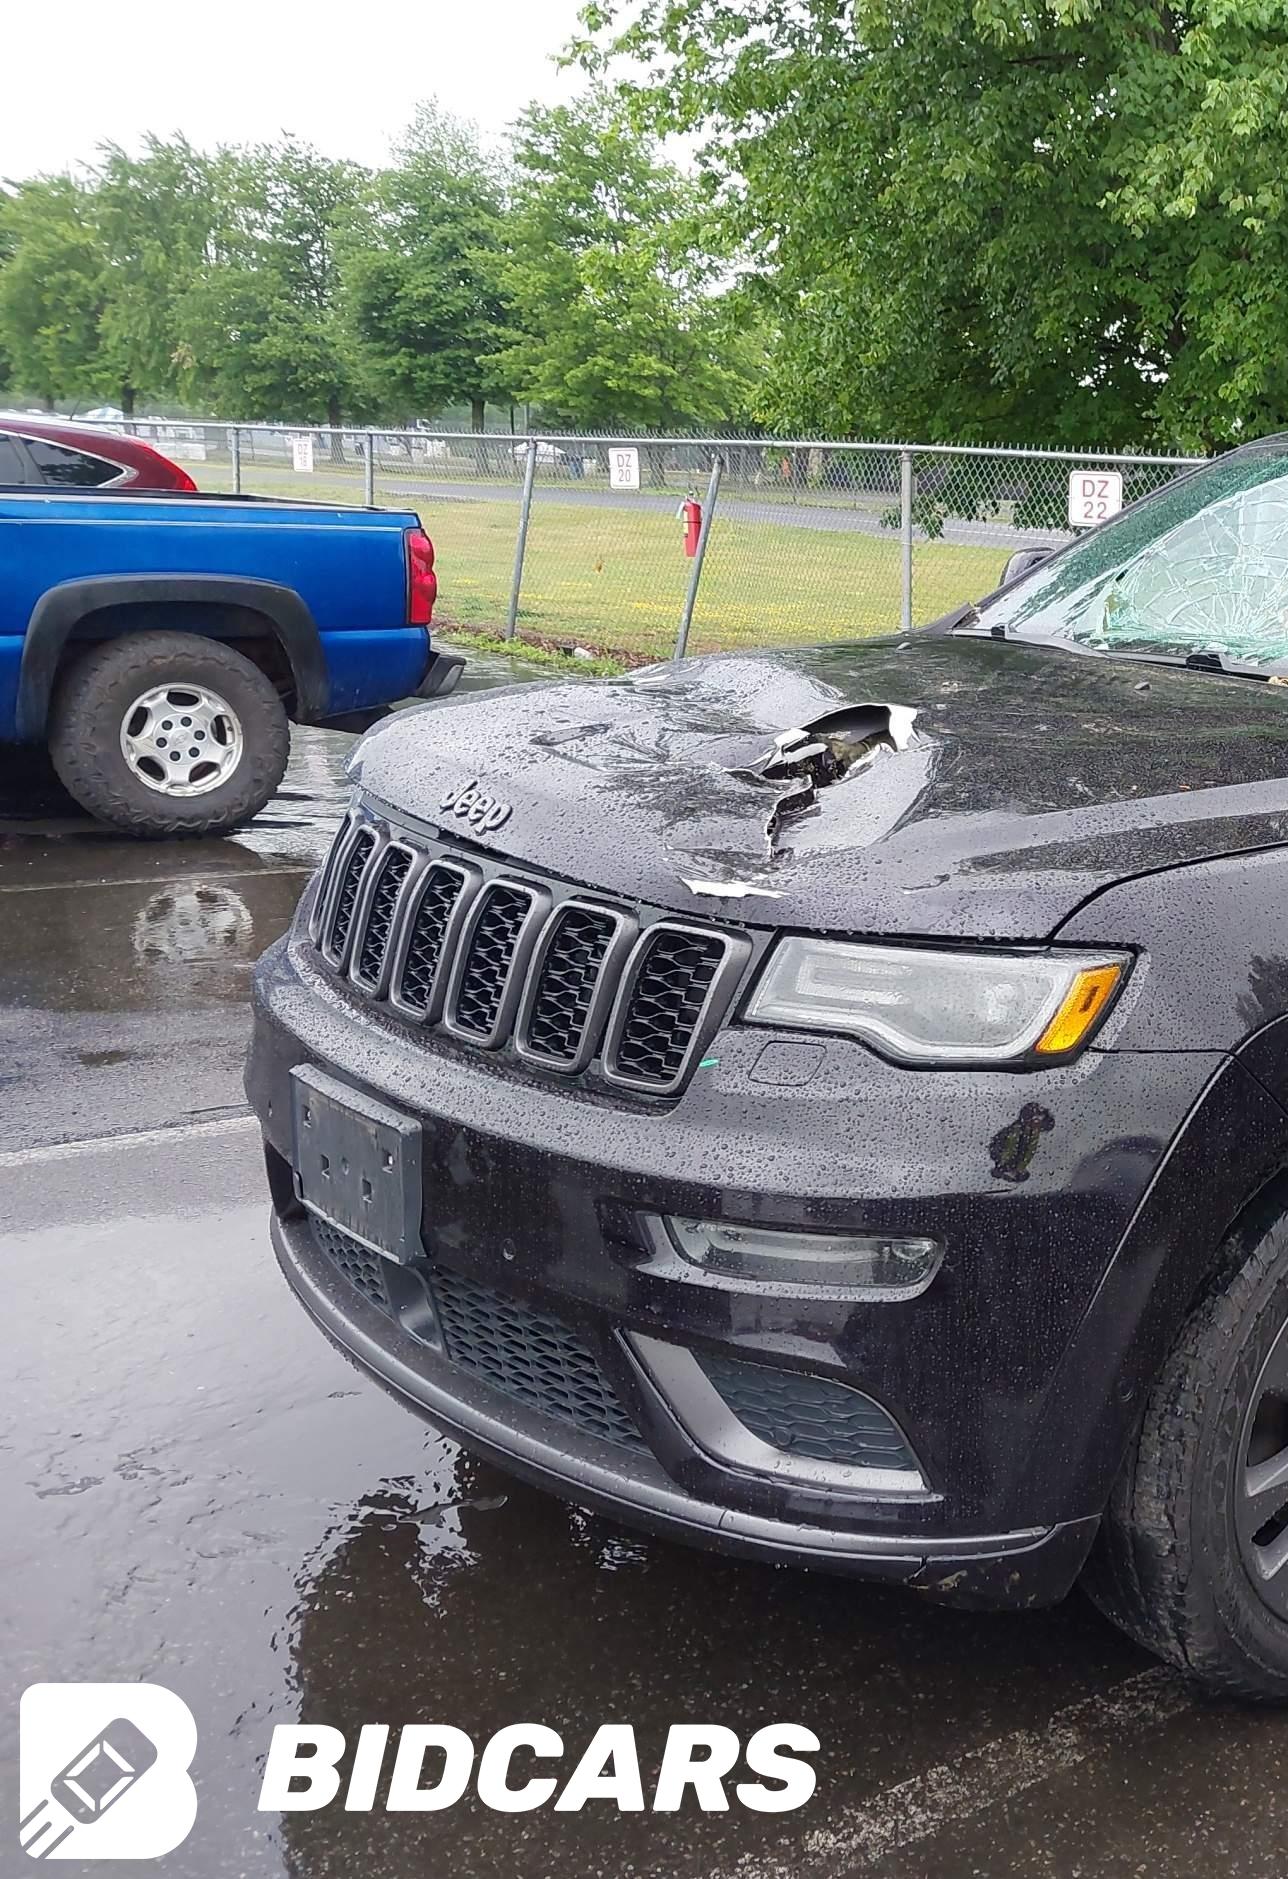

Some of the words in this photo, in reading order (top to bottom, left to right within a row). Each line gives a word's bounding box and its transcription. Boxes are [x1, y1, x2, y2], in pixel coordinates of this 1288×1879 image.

[616, 453, 632, 468] DZ
[618, 469, 631, 482] 20
[1082, 479, 1109, 498] DZ
[1083, 501, 1108, 519] 22
[440, 780, 514, 836] Jeep
